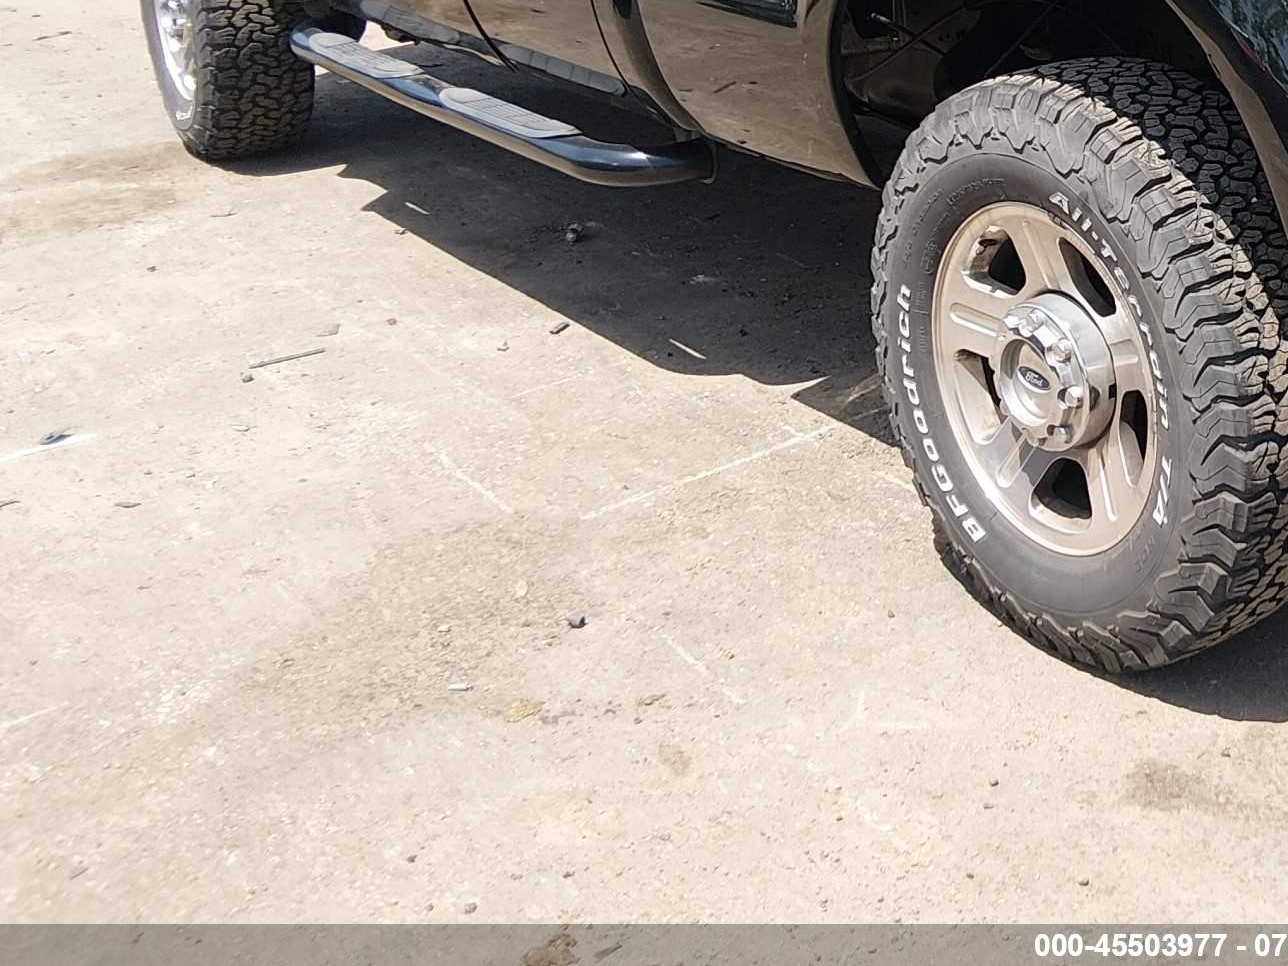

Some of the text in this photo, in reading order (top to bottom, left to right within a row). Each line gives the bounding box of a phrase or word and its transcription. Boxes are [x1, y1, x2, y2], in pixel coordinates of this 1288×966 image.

[896, 283, 987, 544] BFGoodrich
[1025, 370, 1043, 387] Ford
[1048, 191, 1169, 431] All-Terrain
